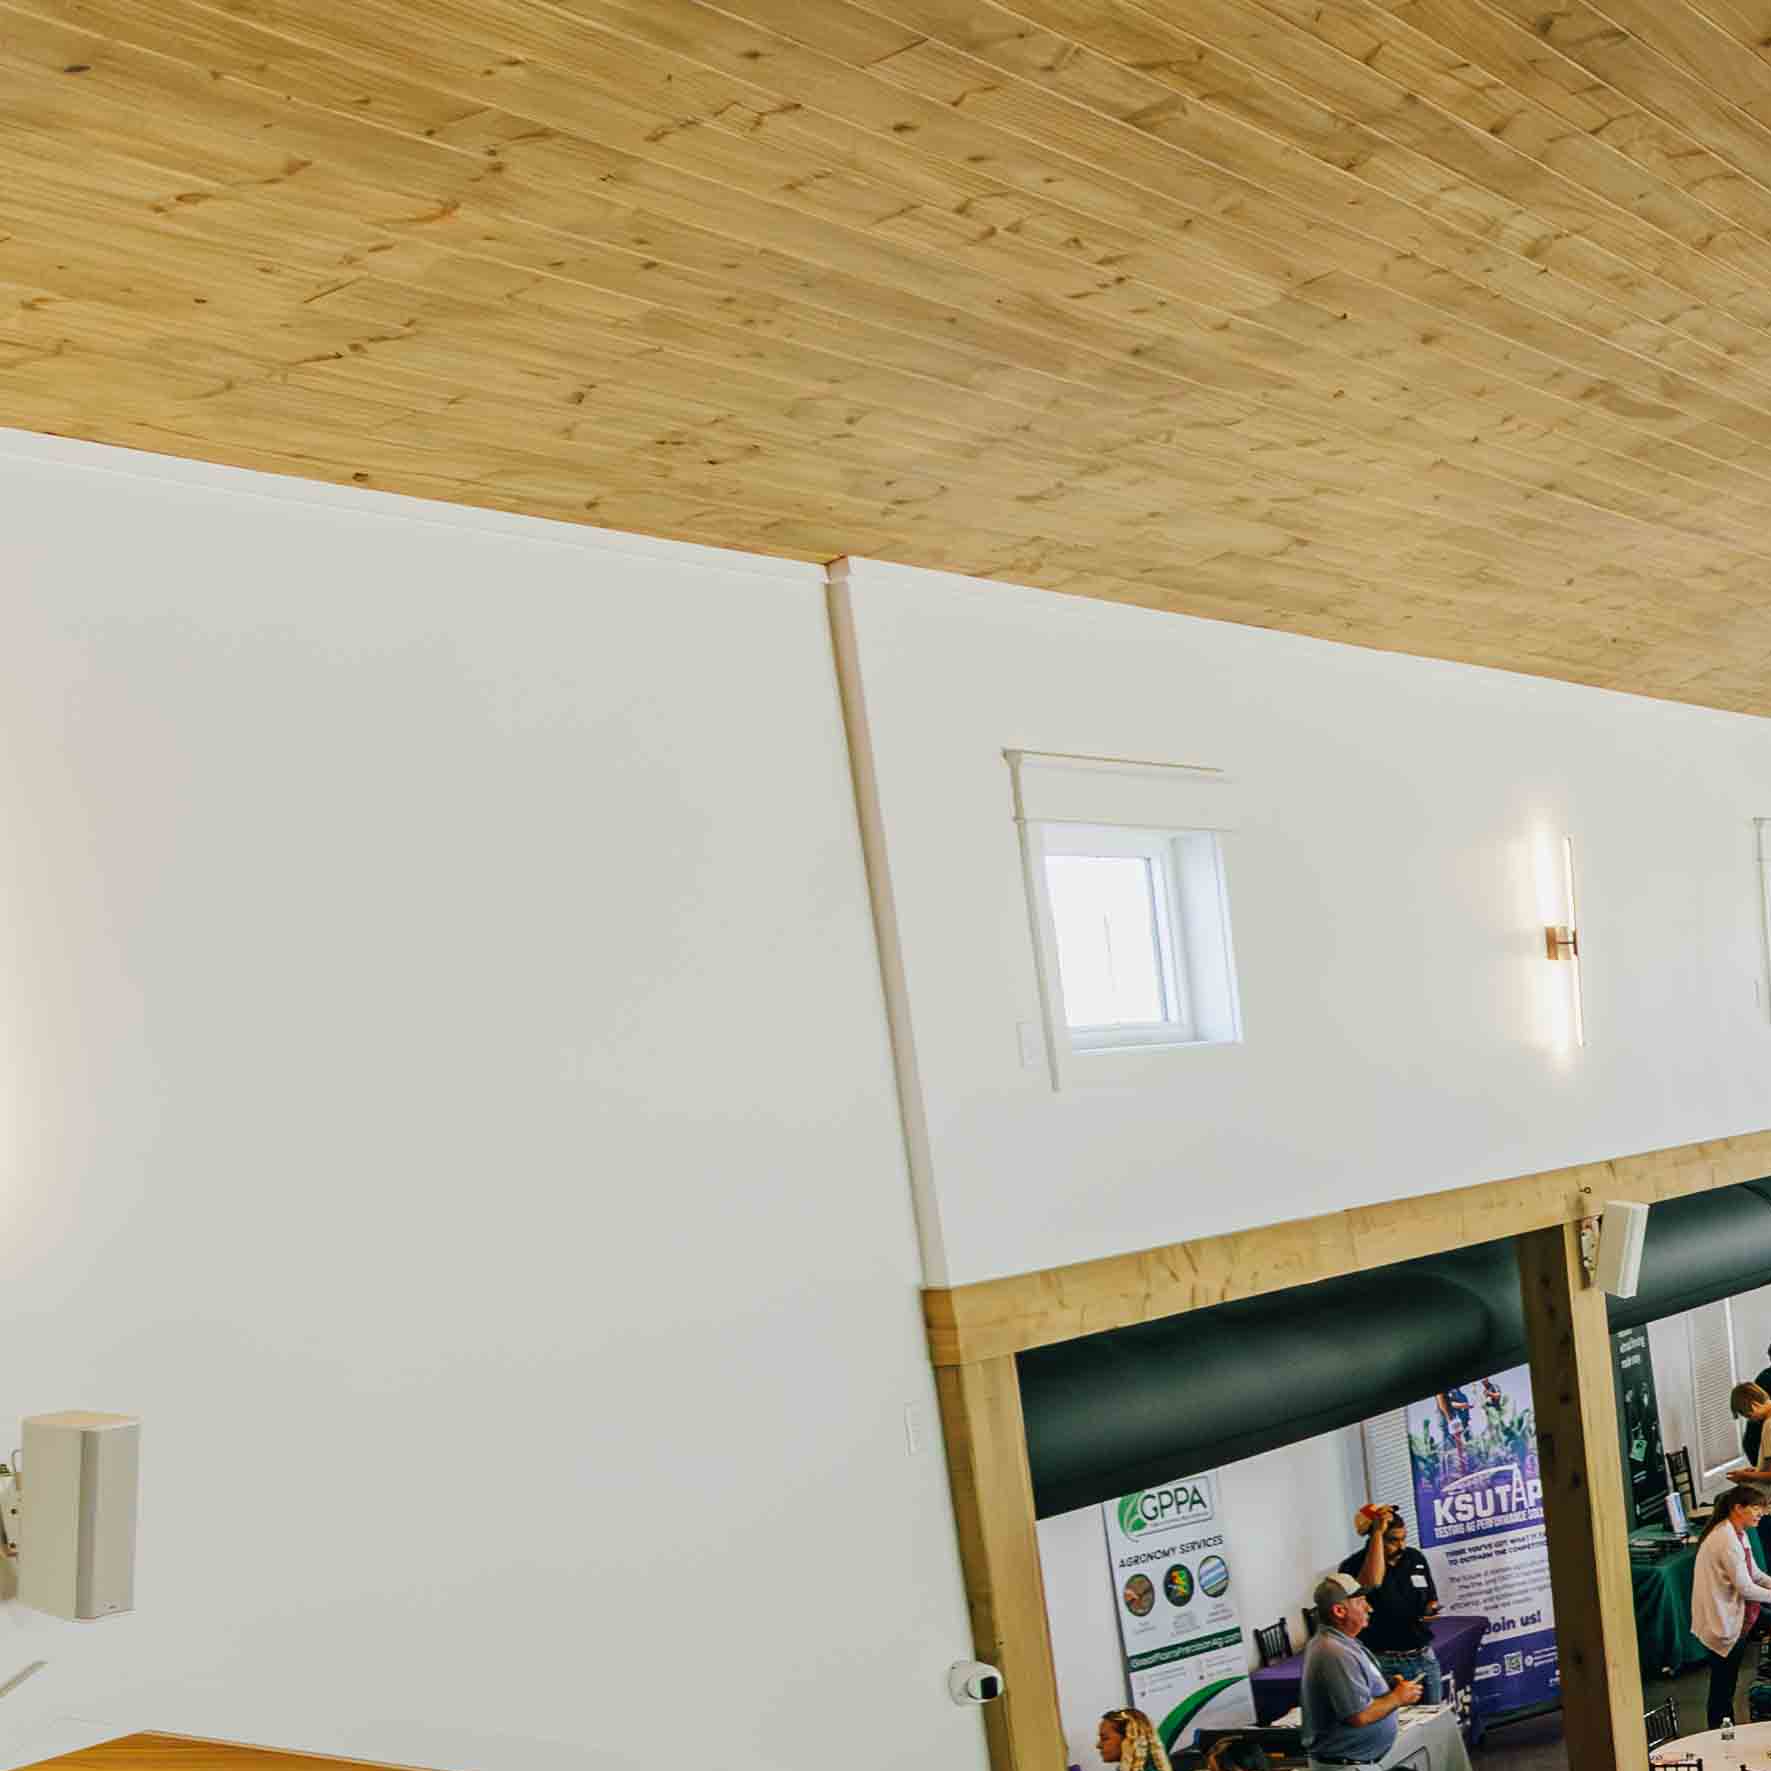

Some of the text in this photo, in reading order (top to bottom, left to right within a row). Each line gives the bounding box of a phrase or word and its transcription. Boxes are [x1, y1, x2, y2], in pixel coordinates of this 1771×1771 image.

[1141, 1486, 1208, 1520] GPPA
[1119, 1535, 1224, 1568] AGRONOMY SERVICES
[1519, 1609, 1542, 1627] us!
